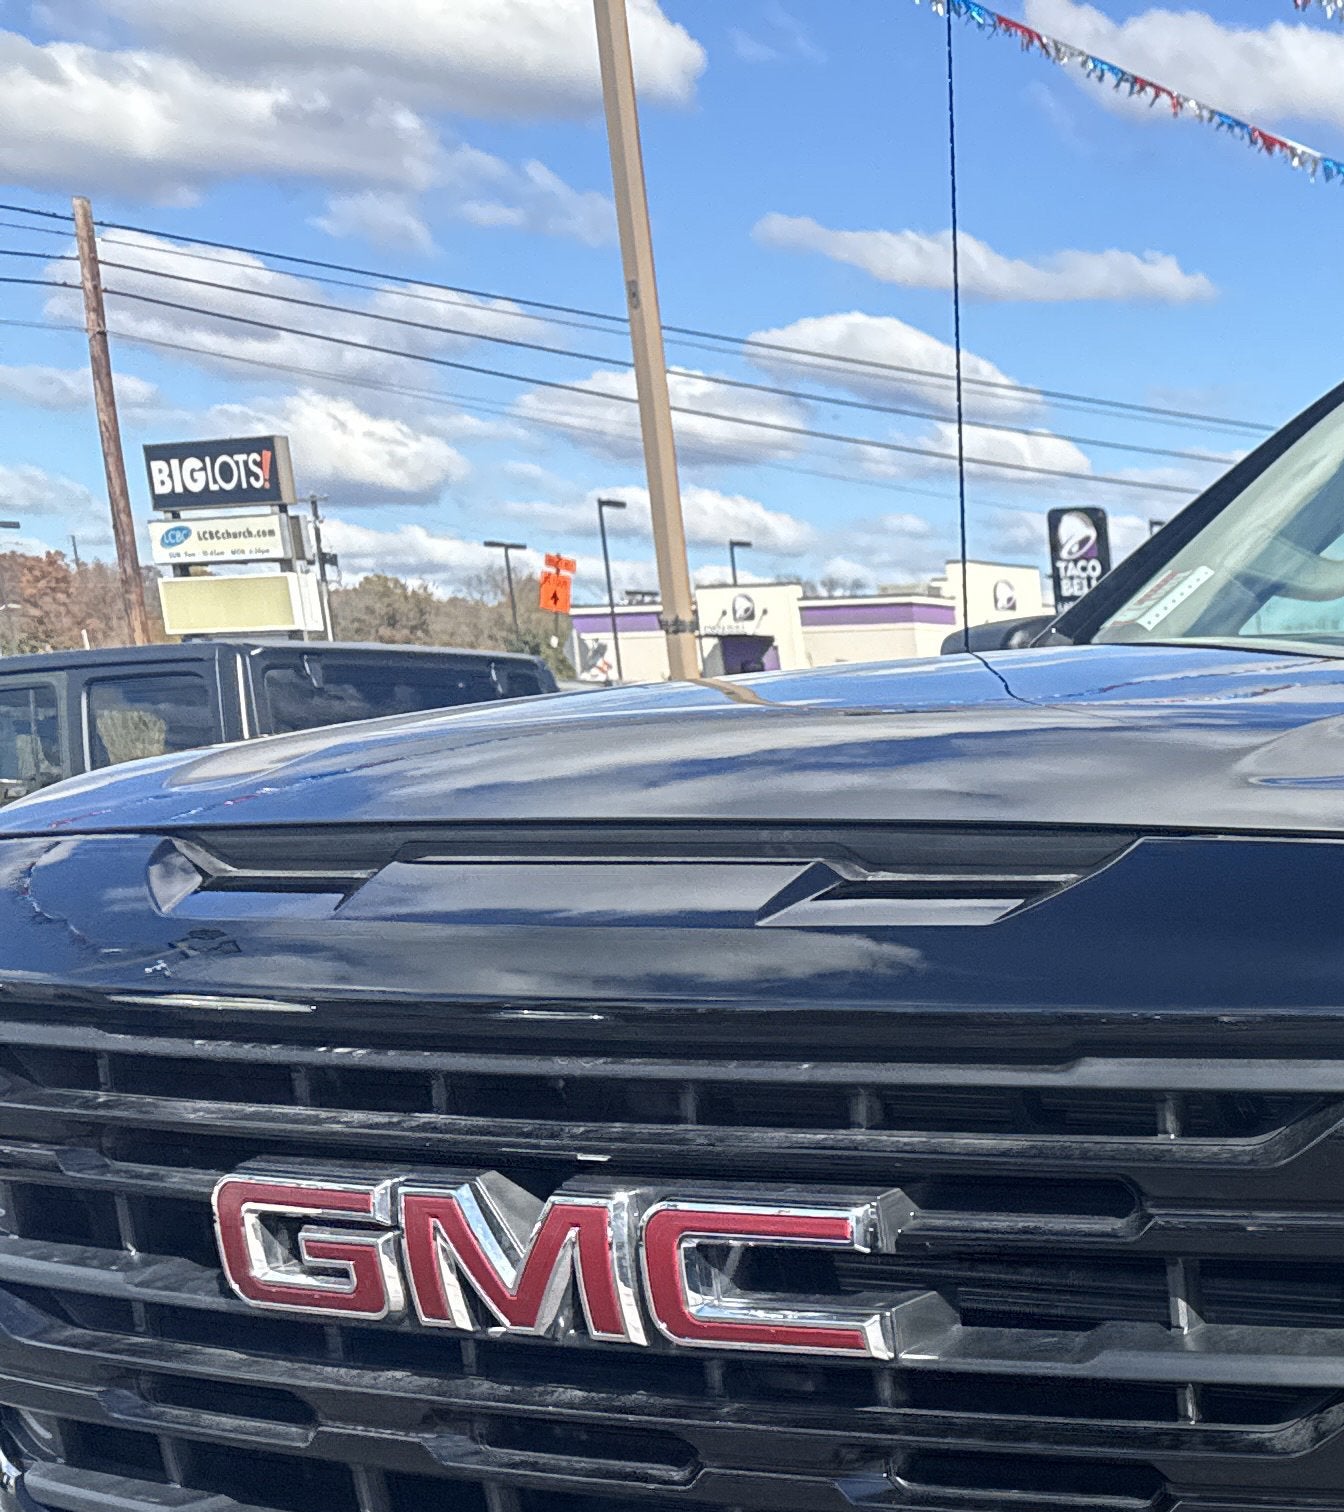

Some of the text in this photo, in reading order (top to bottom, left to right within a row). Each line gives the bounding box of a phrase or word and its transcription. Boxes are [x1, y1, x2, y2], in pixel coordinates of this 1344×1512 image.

[196, 527, 276, 541] LCBCchurch.com
[1056, 558, 1102, 578] TACO
[212, 1171, 902, 1361] GMC
